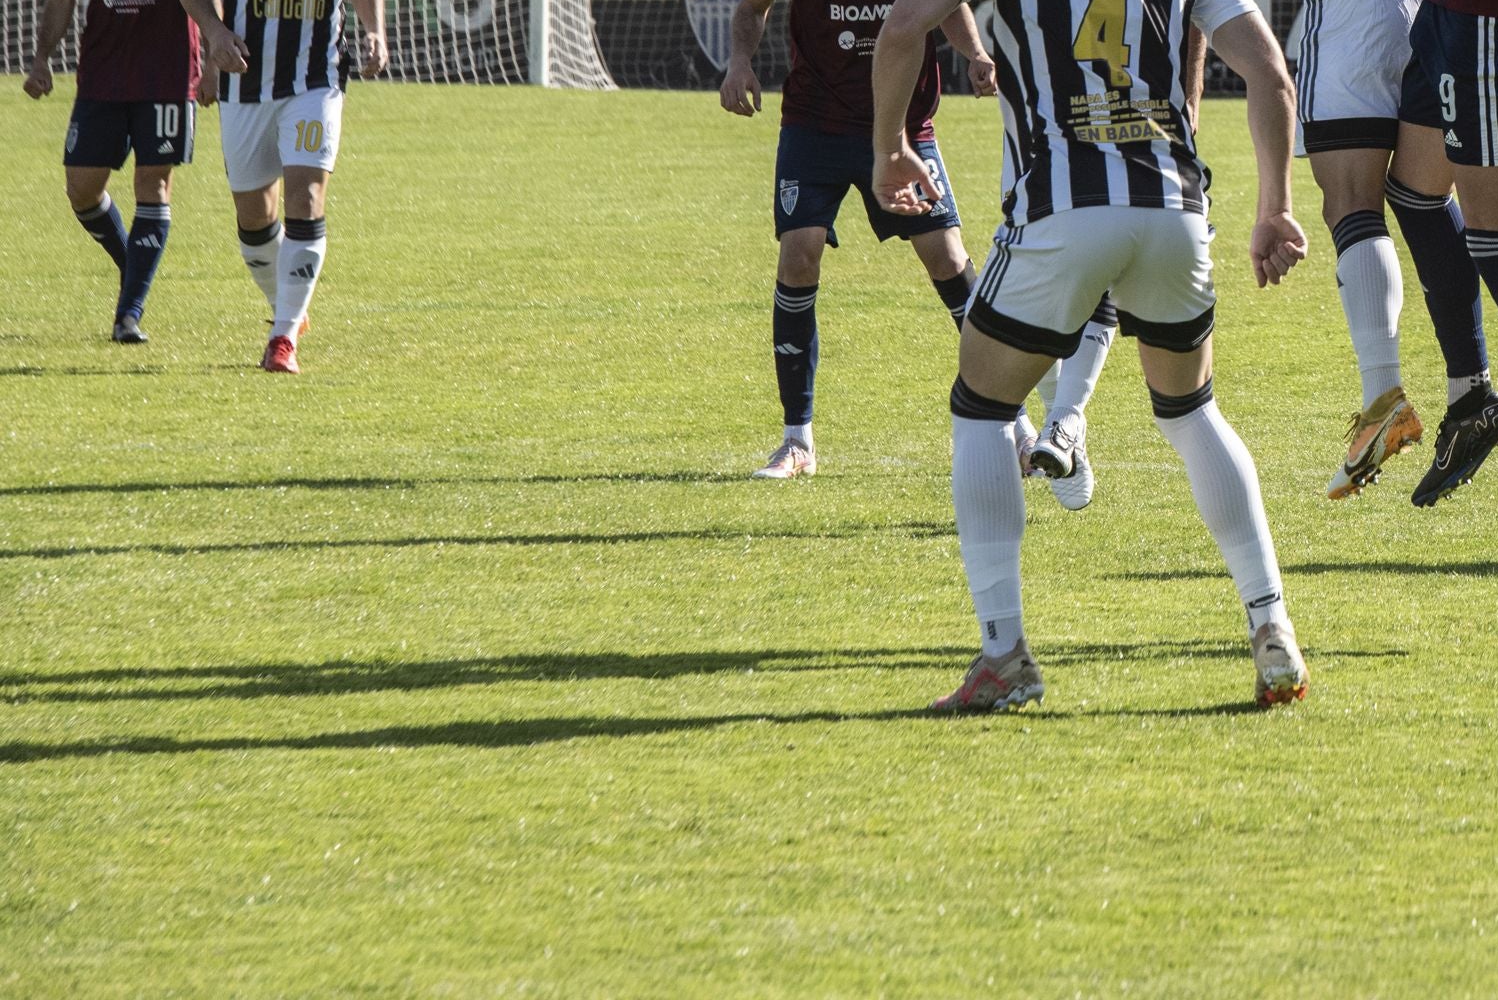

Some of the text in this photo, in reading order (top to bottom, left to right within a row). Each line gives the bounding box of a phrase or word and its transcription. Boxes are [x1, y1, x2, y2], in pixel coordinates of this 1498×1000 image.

[1439, 73, 1457, 123] 9
[154, 103, 179, 138] 10
[295, 119, 323, 153] 10
